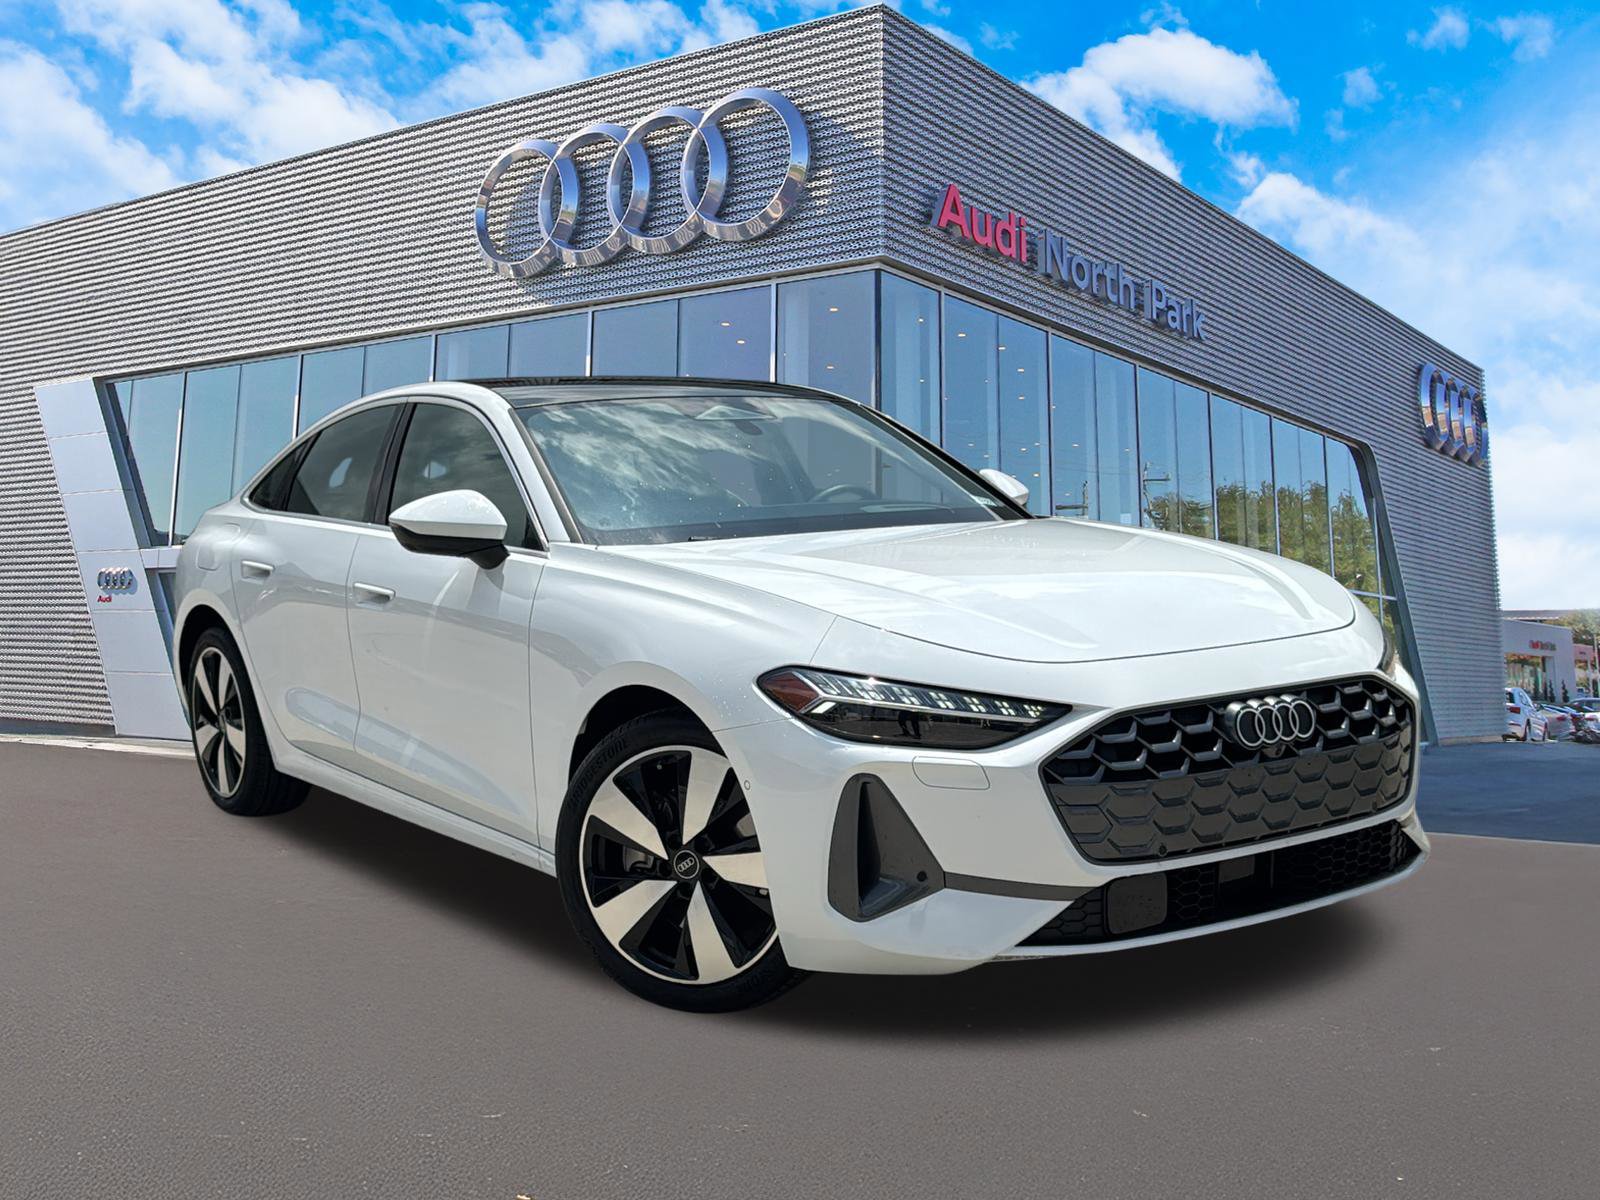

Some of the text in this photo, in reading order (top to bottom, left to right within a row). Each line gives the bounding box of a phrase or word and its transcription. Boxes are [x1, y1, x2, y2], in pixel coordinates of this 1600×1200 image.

[936, 184, 1207, 341] Audi North Park
[97, 595, 112, 603] Audi
